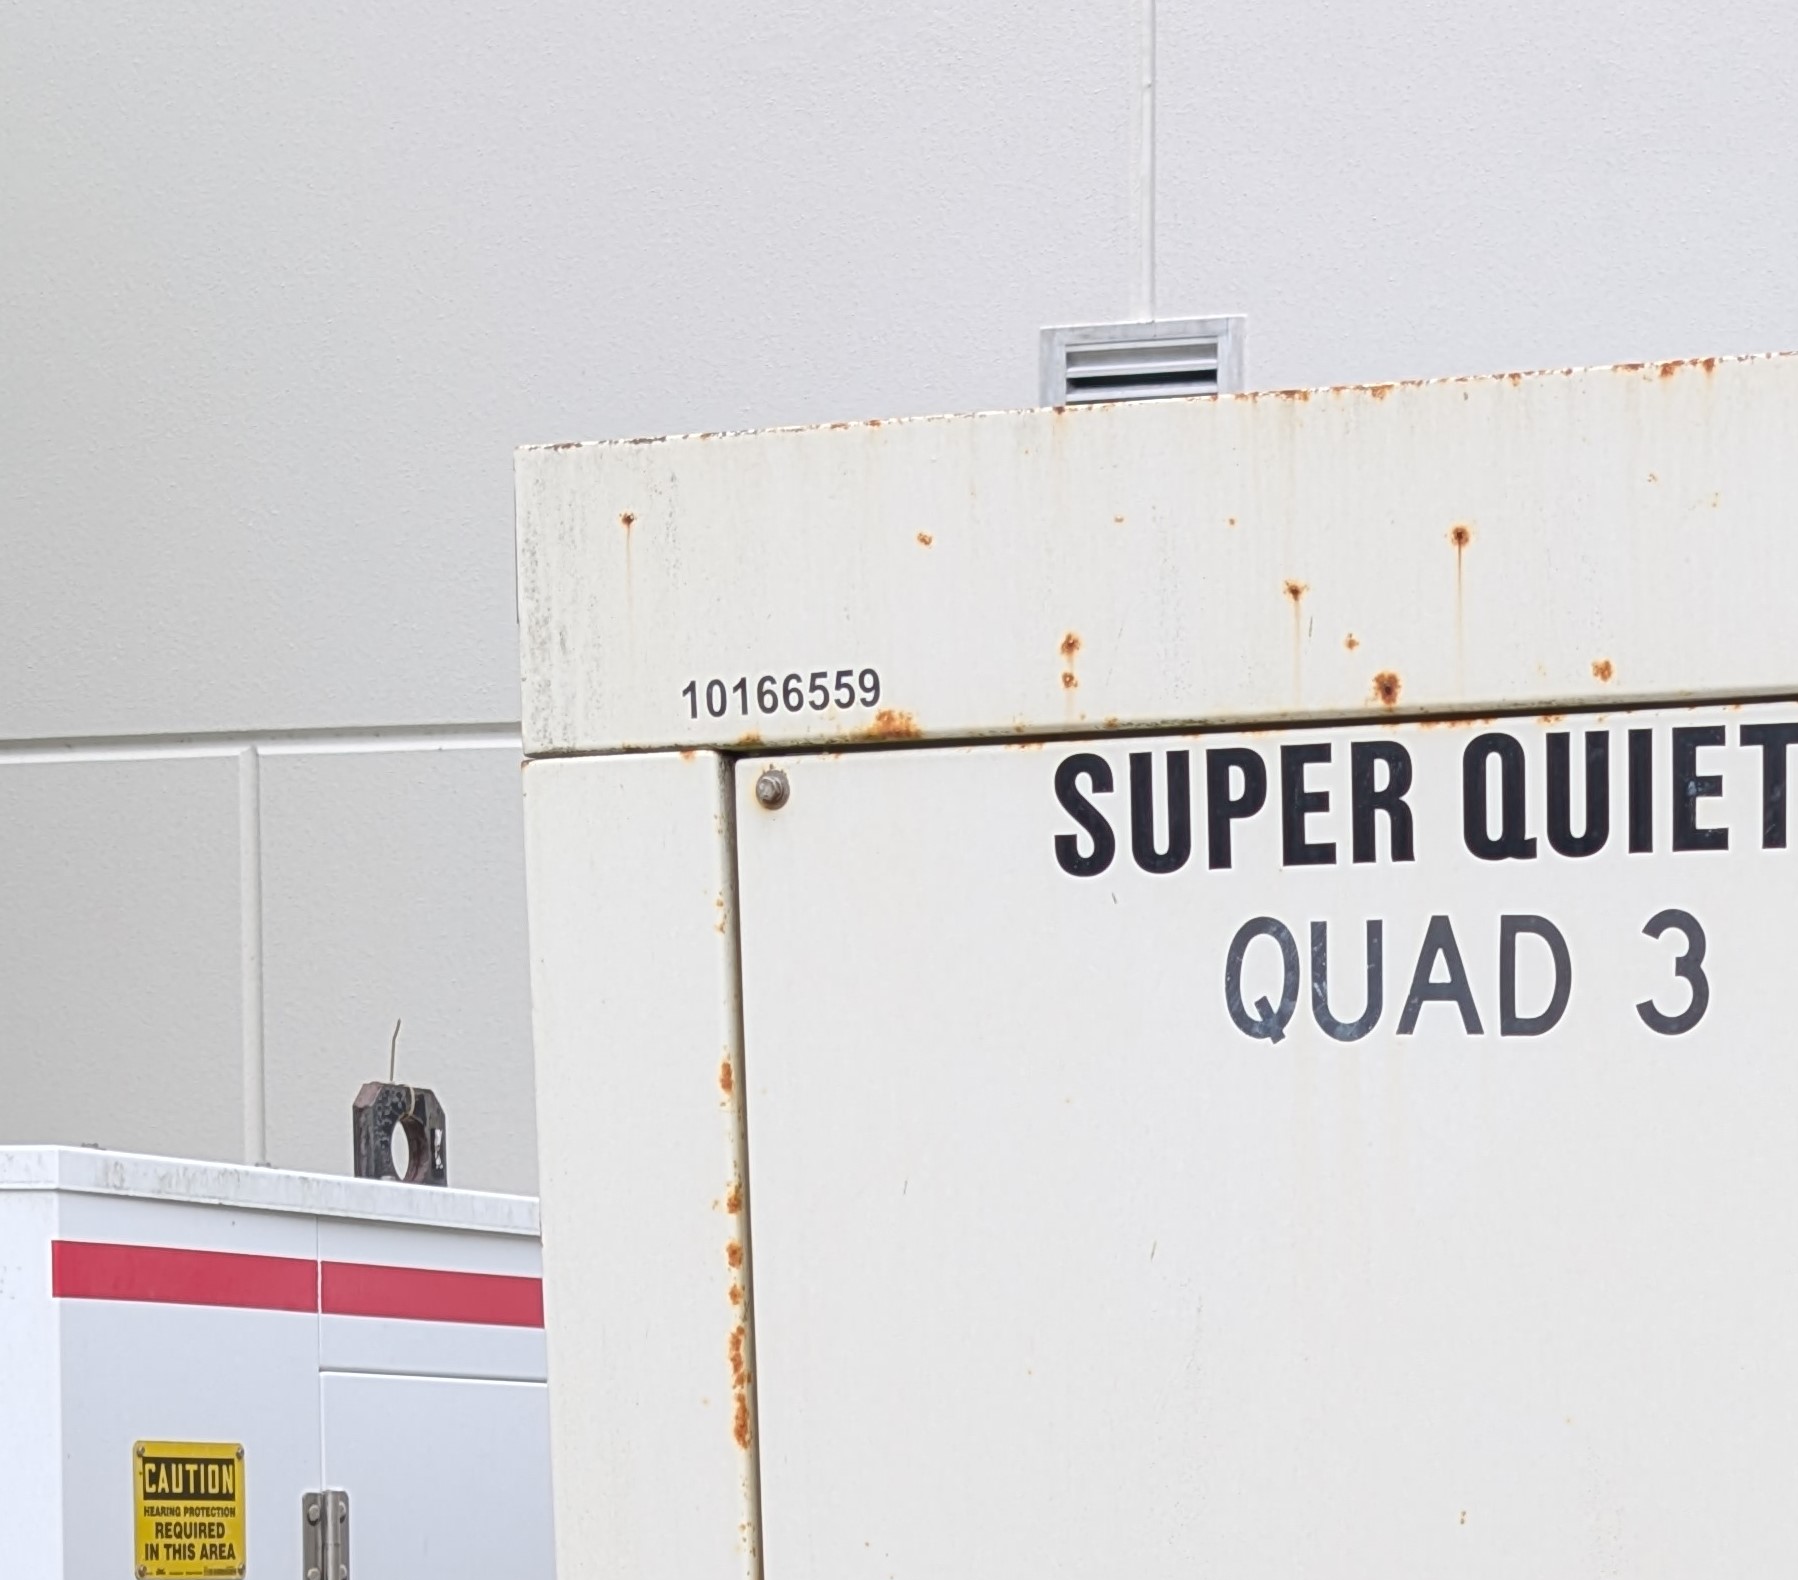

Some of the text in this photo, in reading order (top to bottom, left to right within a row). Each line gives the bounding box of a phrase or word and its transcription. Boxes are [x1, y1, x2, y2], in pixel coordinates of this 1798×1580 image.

[682, 668, 881, 719] 10166559
[1053, 738, 1416, 878] SUPER
[1222, 907, 1711, 1044] QUAD 3
[144, 1463, 234, 1494] CAUTION
[143, 1506, 236, 1518] HEARING PROTECTION
[155, 1522, 226, 1539] REQUIRED
[144, 1543, 236, 1561] IN THIS AREA
